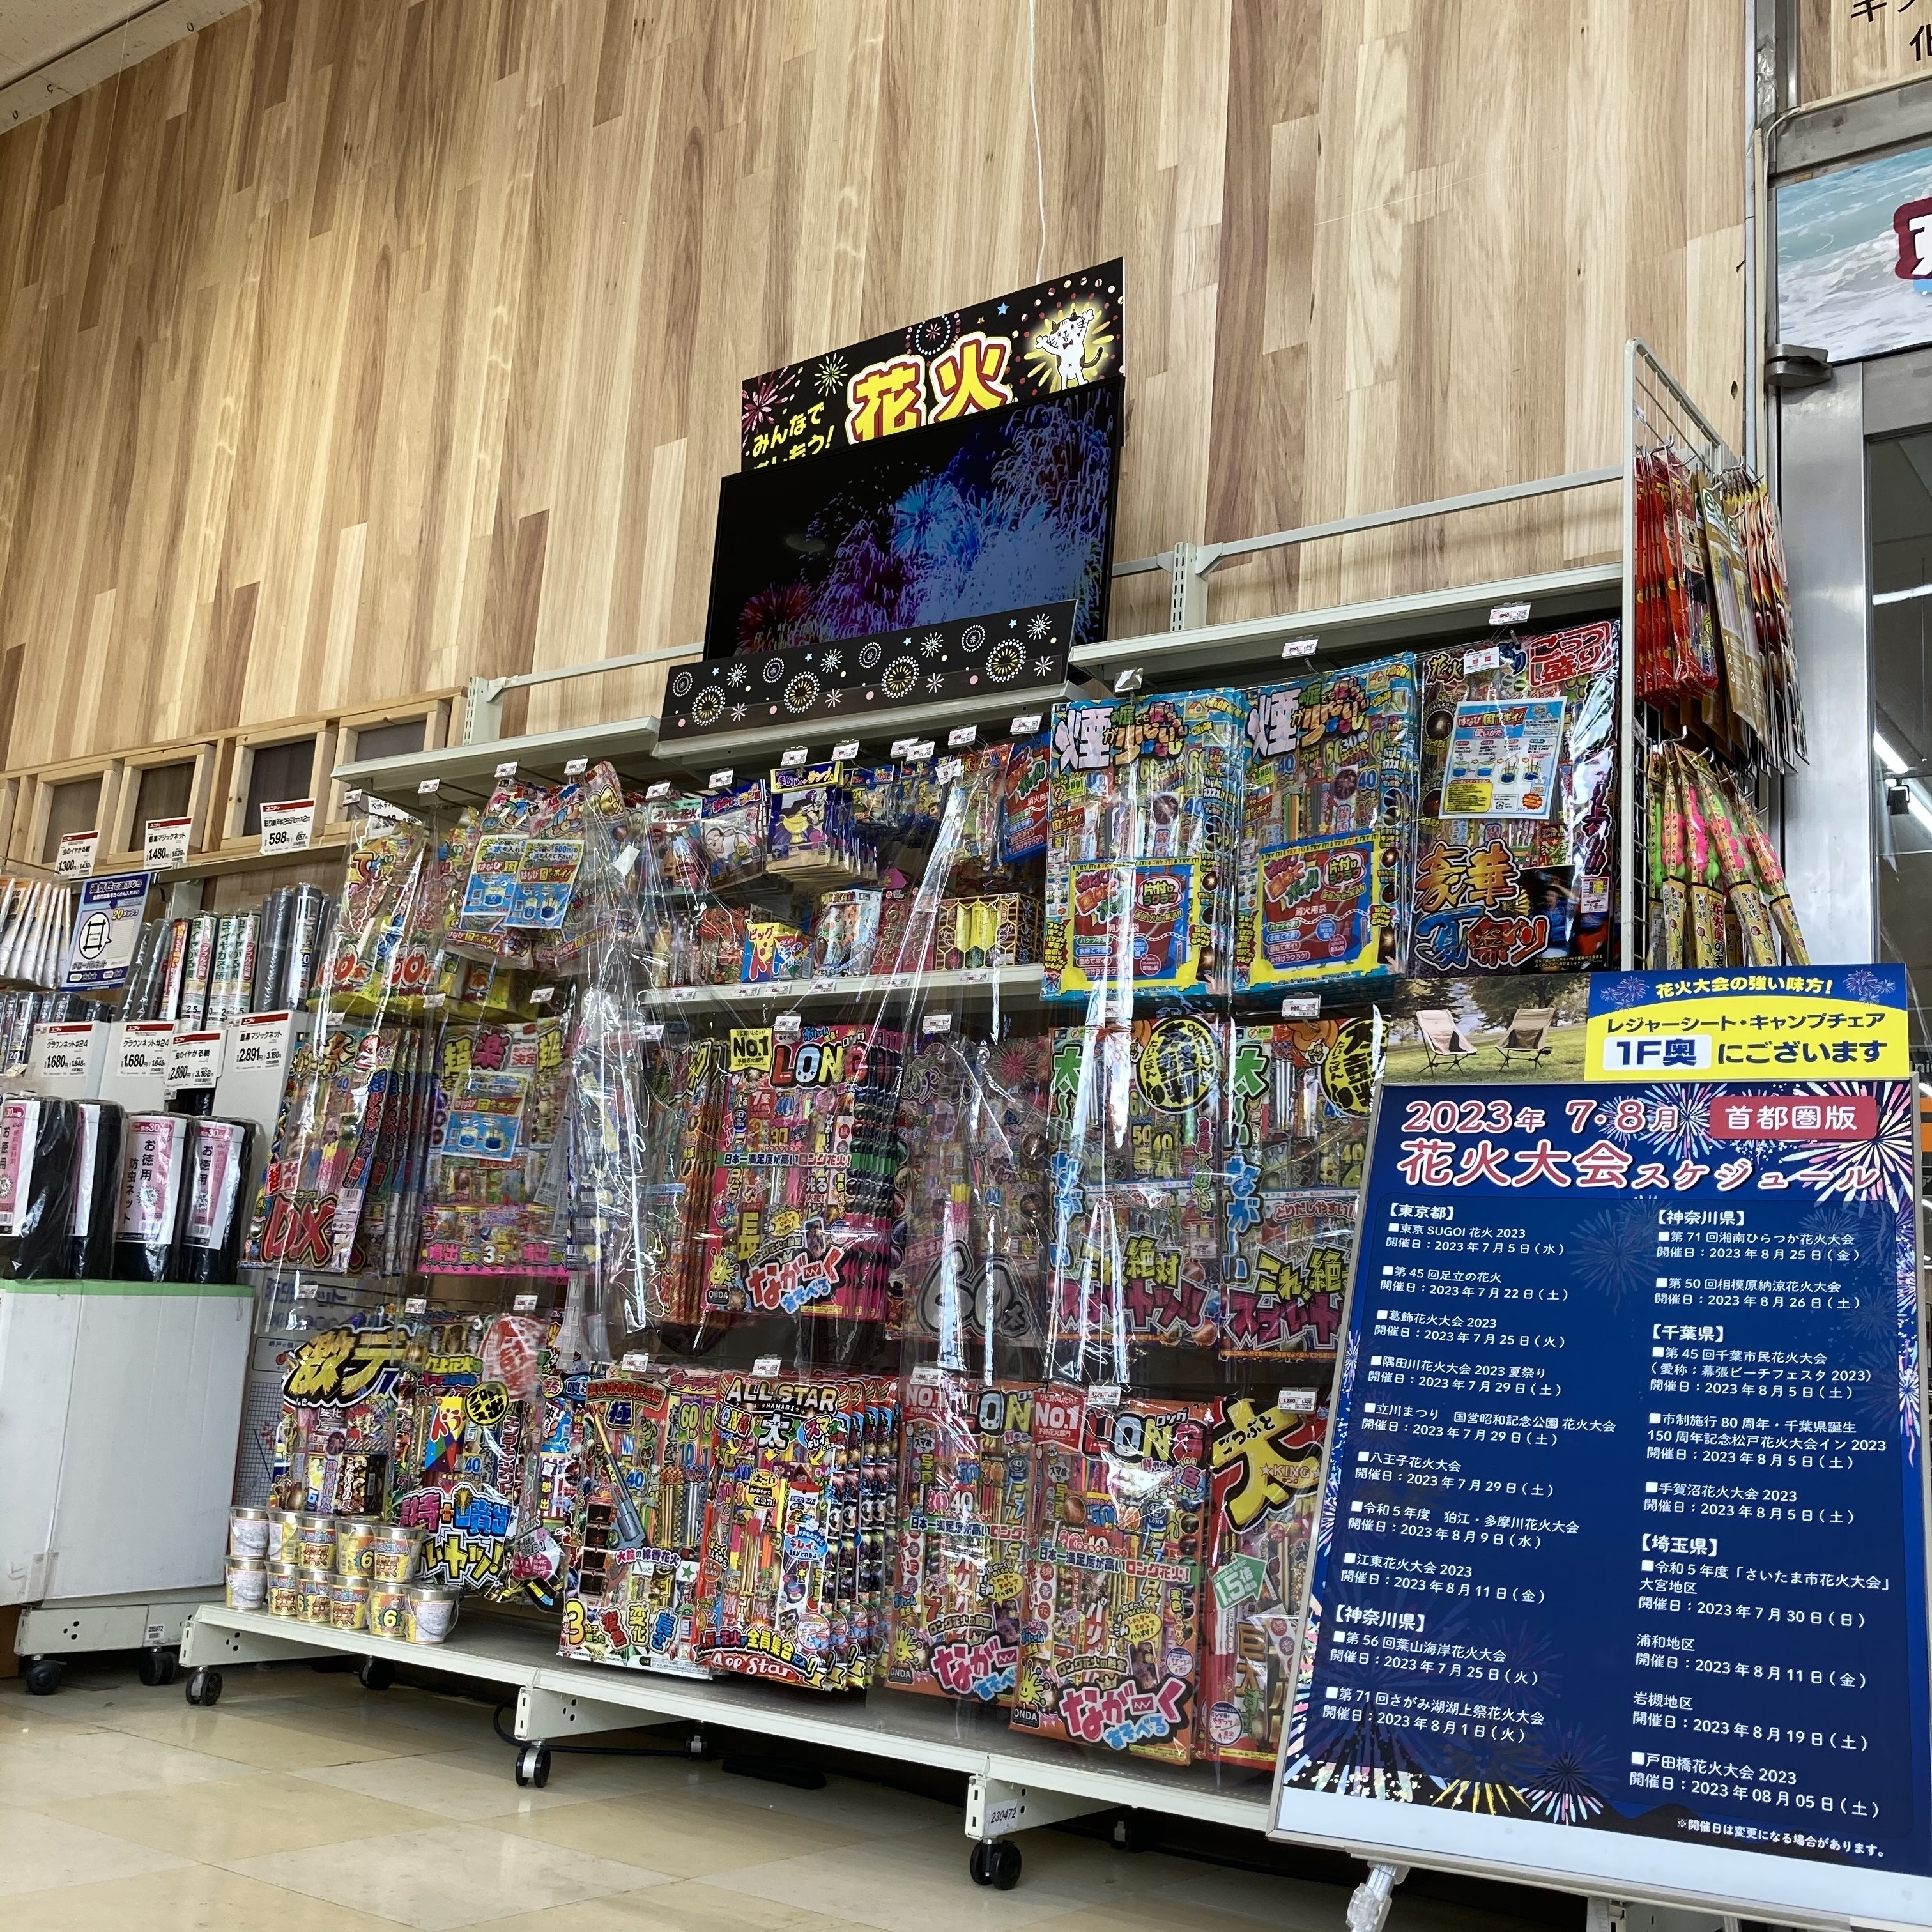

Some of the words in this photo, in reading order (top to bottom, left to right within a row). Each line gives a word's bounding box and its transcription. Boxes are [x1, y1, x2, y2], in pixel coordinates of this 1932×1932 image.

[847, 332, 1012, 444] 花火
[752, 401, 825, 457] みんなで
[1248, 689, 1301, 758] 煙
[1055, 707, 1114, 773] 煙
[1358, 768, 1378, 790] 40
[1328, 856, 1358, 874] 片付け
[1329, 867, 1362, 884] ラクラク
[1416, 841, 1519, 912] 豪華
[1144, 881, 1175, 895] 片付け
[1144, 893, 1179, 905] ラクラク
[1295, 905, 1327, 916] 消火用袋
[749, 925, 775, 940] ビッグ
[1415, 906, 1548, 969] 夏祭り
[1655, 975, 1834, 999] 花火大会の強い味方!
[1607, 1012, 1886, 1034] レジャーシート・キャンプチェア
[1329, 1041, 1345, 1080] たいこばん
[1615, 1038, 1698, 1067] 1F奥
[1718, 1038, 1887, 1064] にございます
[1402, 1101, 1545, 1134] 2023年
[1566, 1098, 1678, 1133] 7・8月
[1724, 1105, 1859, 1131] 首都圏版
[140, 1140, 155, 1181] お徳用
[122, 1158, 139, 1224] 防虫ネット
[1390, 1202, 1454, 1220] 【東京都】
[1656, 1209, 1745, 1227] 【神奈川県】
[264, 1196, 334, 1264] DX
[1400, 1223, 1423, 1235] 東京
[1427, 1226, 1466, 1236] SUGOI
[1469, 1227, 1493, 1238] 花火
[1497, 1228, 1526, 1238] 2023
[1389, 1311, 1462, 1328] 葛飾花火大会
[1467, 1318, 1497, 1328] 2023
[1652, 1324, 1724, 1342] 【千葉県】
[1383, 1357, 1471, 1374] 隅田川花火大会
[1475, 1365, 1505, 1376] 2023
[1509, 1367, 1546, 1378] 夏祭り
[727, 1377, 772, 1403] ALL
[777, 1383, 838, 1412] STAR
[680, 1404, 699, 1429] 60
[766, 1403, 795, 1411] HANABI
[1035, 1402, 1080, 1429] No.1
[1156, 1408, 1188, 1426] ロング
[1376, 1404, 1439, 1420] 立川まつり
[1454, 1411, 1558, 1429] 国営昭和記念公園
[1562, 1418, 1616, 1432] 花火大会
[1087, 1409, 1204, 1463] LONG
[1218, 1414, 1275, 1455] ごつぶと
[1851, 1439, 1886, 1452] 2023
[981, 1460, 1003, 1484] 30
[1273, 1464, 1310, 1478] KING
[1369, 1452, 1461, 1473] 八王子花火大会
[626, 1470, 645, 1487] 40
[927, 1489, 948, 1514] 30
[1659, 1482, 1759, 1501] 手賀沼花火大会
[1763, 1489, 1797, 1502] 2023
[1444, 1512, 1579, 1534] 狛江・多摩川花火大会
[1641, 1533, 1717, 1556] 【埼玉県】
[617, 1548, 680, 1565] 大輪の線香花火
[1039, 1547, 1189, 1582] 日本一満足度が高いロング花火!
[1356, 1554, 1438, 1574] 江東花火大会
[1440, 1565, 1472, 1577] 2023
[1639, 1579, 1698, 1595] 大宮地区
[385, 1610, 396, 1625] 6
[566, 1598, 585, 1644] 3
[629, 1605, 647, 1643] 変化
[1335, 1604, 1425, 1632] 【神奈川県】
[651, 1612, 676, 1650] 長さ
[1636, 1634, 1696, 1651] 浦和地区
[890, 1667, 911, 1678] ONDA
[1057, 1657, 1127, 1675] ロング花火の殿堂
[1633, 1691, 1694, 1710] 岩槻地区
[1014, 1710, 1038, 1721] ONDA
[1105, 1715, 1169, 1748] あそべる
[1646, 1753, 1755, 1781] 戸田橋花火大会
[1759, 1768, 1797, 1784] 2023
[990, 1807, 1016, 1824] 230472
